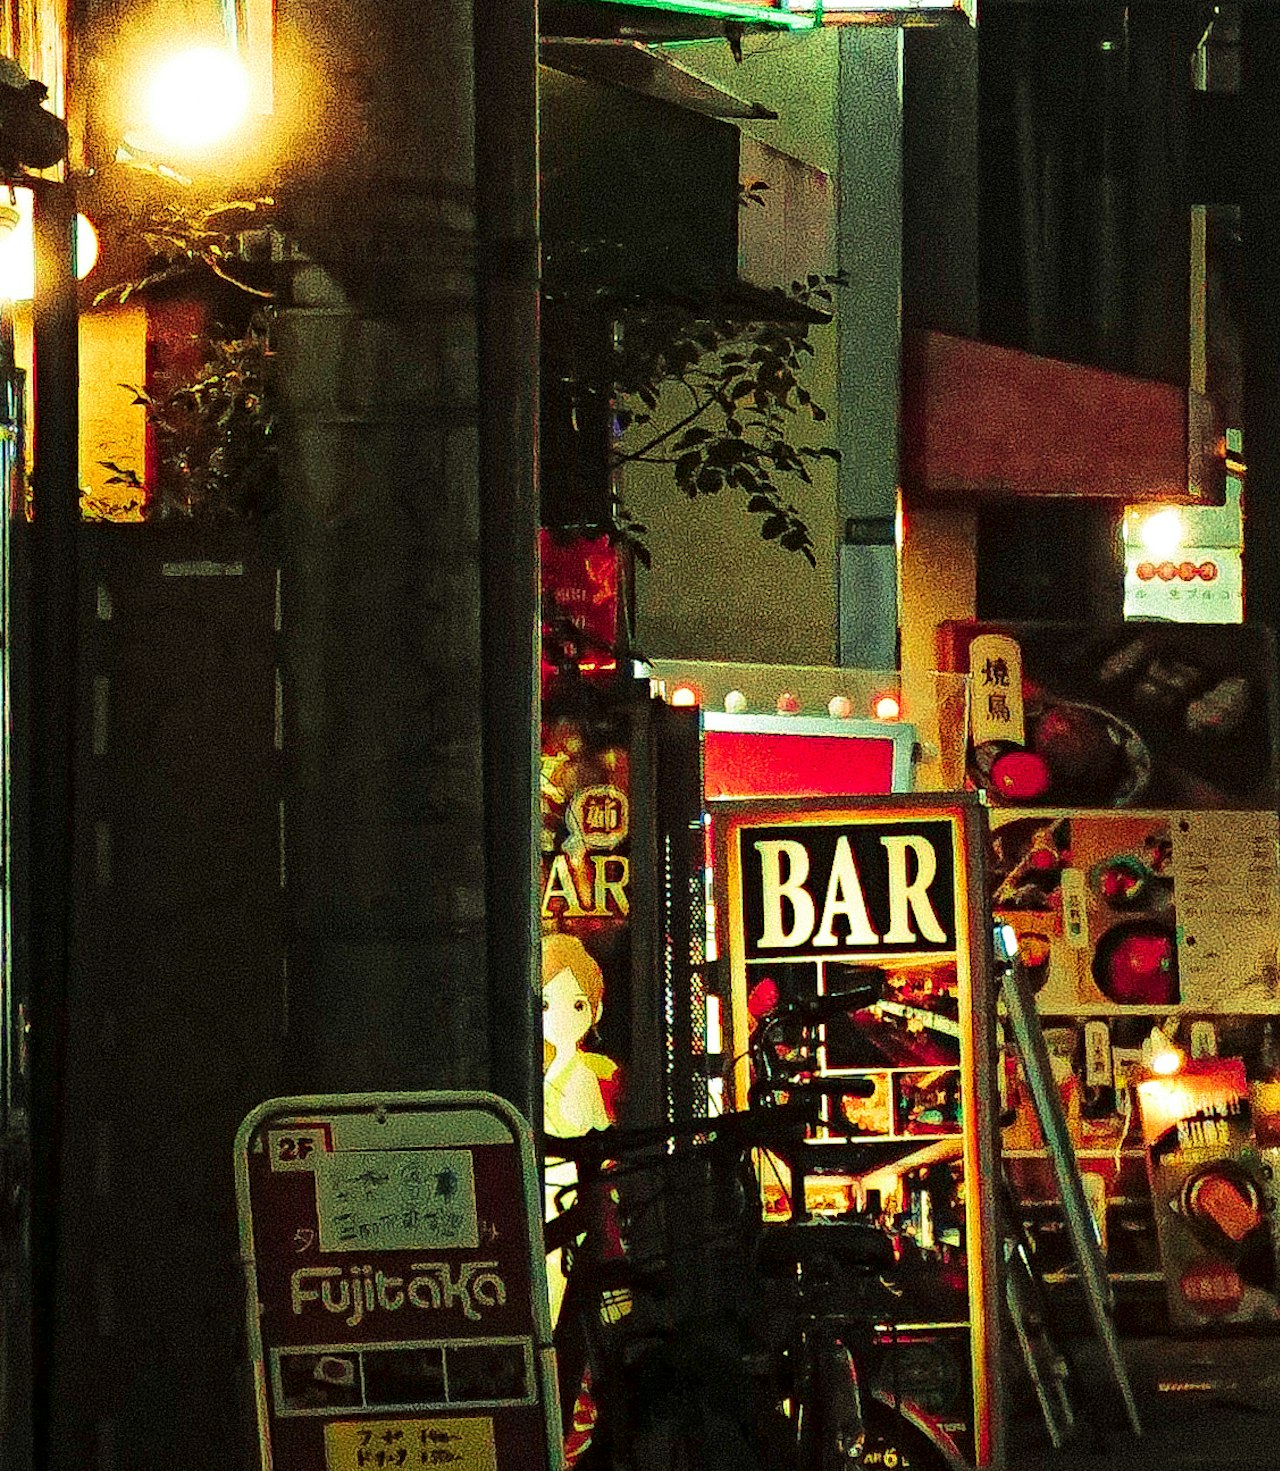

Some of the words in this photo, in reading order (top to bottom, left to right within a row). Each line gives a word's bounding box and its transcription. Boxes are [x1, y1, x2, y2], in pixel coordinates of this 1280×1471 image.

[755, 832, 951, 953] BAR
[277, 1137, 314, 1162] 2F
[290, 1260, 508, 1327] Fujitaka
